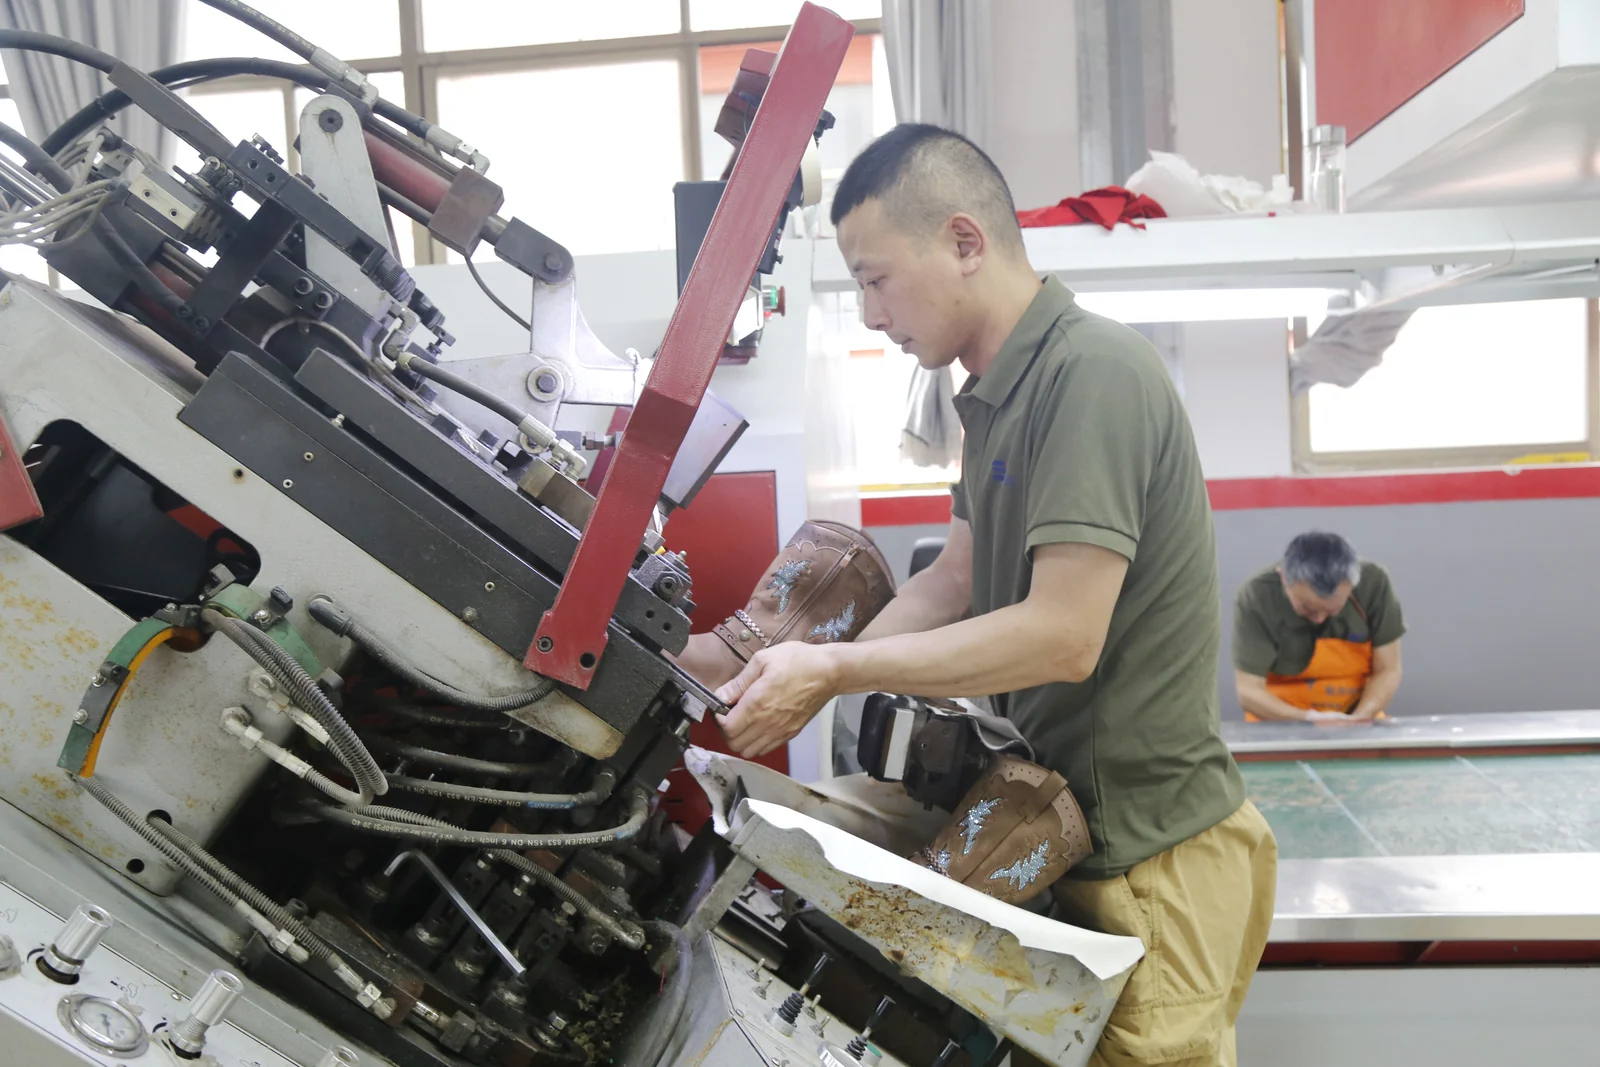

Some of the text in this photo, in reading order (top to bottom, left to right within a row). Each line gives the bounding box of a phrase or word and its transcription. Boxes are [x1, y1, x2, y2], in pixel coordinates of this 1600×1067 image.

[464, 795, 502, 805] 20022/EN
[480, 837, 499, 845] inch
[511, 838, 524, 846] DN
[527, 838, 544, 846] 1SN
[547, 838, 562, 846] 853
[565, 836, 599, 845] 20022/EN
[601, 834, 613, 842] DIN
